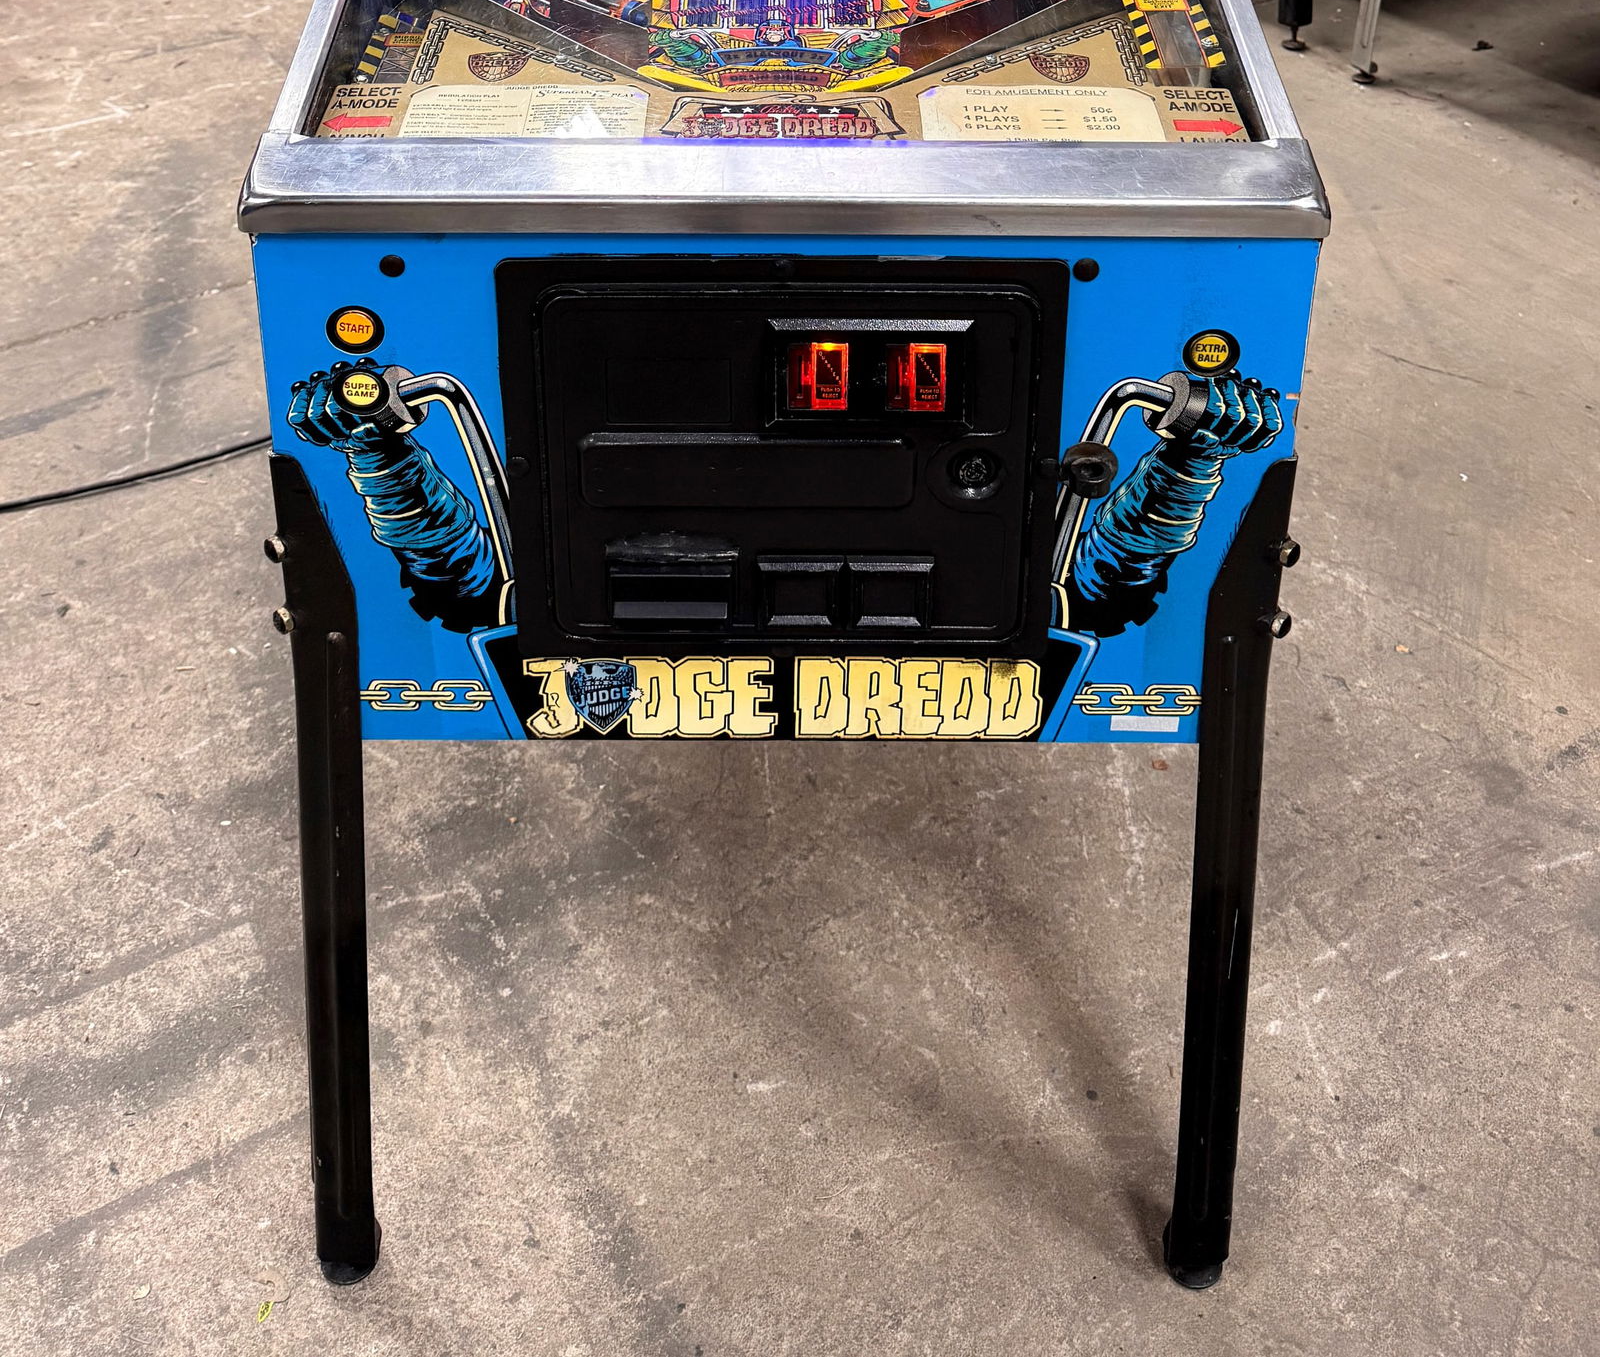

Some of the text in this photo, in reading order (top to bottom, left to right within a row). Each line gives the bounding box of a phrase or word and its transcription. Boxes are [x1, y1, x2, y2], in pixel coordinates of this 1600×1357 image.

[336, 87, 402, 98] SELECT-
[1163, 89, 1230, 101] SELECT-
[331, 99, 400, 110] A-MODE
[973, 105, 1009, 113] PLAY
[1169, 101, 1236, 113] A-MODE
[780, 117, 879, 138] DREDD
[338, 322, 371, 334] START
[1195, 343, 1227, 354] EXTRA
[1197, 353, 1221, 363] BALL
[344, 381, 378, 391] SUPER
[346, 389, 376, 399] GAME
[577, 686, 630, 709] JUDGE
[794, 656, 1043, 739] DREDD
